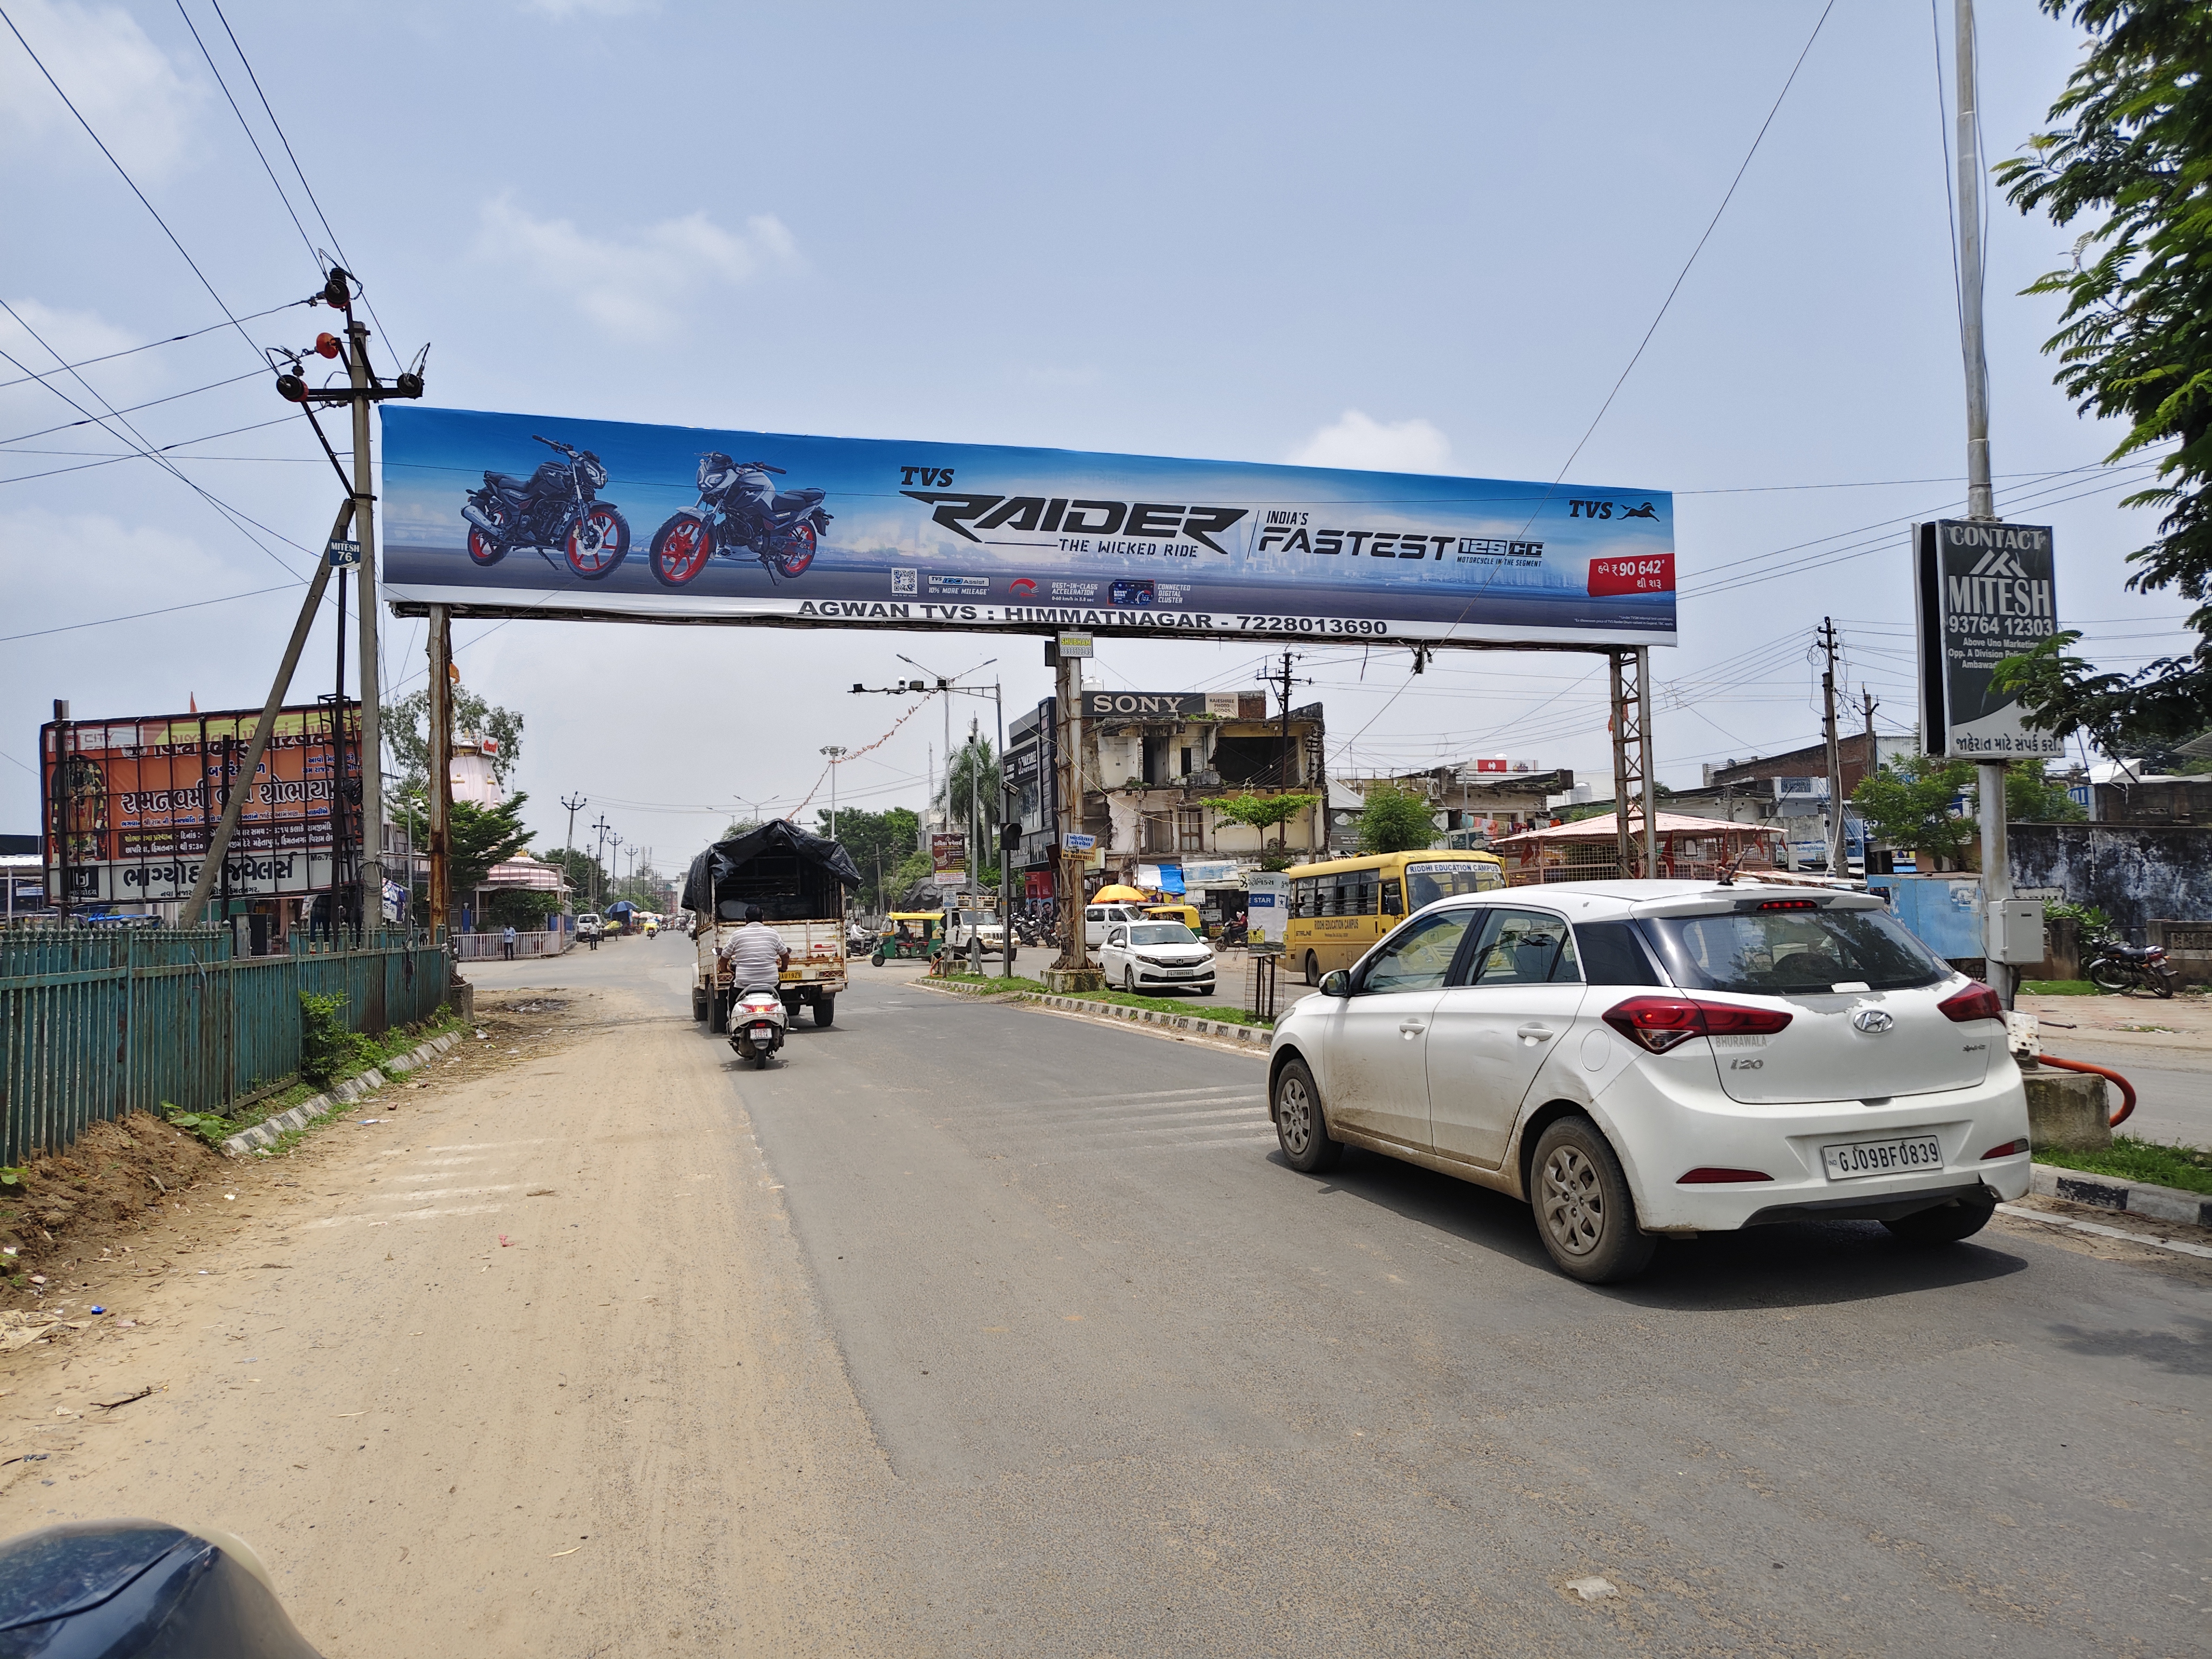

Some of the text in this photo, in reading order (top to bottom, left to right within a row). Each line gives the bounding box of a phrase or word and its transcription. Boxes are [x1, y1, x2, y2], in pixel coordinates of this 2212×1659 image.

[900, 466, 954, 487] TVS
[1266, 510, 1309, 525] INDIA'S
[1569, 500, 1613, 519] TVS
[899, 491, 1249, 554] RAIDER
[1258, 526, 1456, 560] FASTEST
[1950, 526, 2043, 550] CONTACT
[331, 542, 360, 552] MITESH
[1058, 538, 1198, 558] THE WICKED RIDE
[338, 551, 353, 562] 76
[1457, 556, 1494, 564] MOTORCYCLE
[1598, 562, 1609, 574] હવે
[1637, 577, 1646, 588] થી
[1948, 576, 2051, 617] MITESH
[797, 601, 909, 617] AGWAN
[920, 604, 977, 619] TVS
[988, 609, 994, 620] :
[1006, 608, 1213, 628] HIMMATNAGAR
[1236, 616, 1387, 635] 7228013690
[1948, 615, 2052, 636] 93764 12303
[1061, 637, 1091, 646] SHUBHAM
[1963, 637, 1985, 646] Above
[1987, 638, 2001, 647] Uno
[1948, 648, 1965, 659] Opp.
[1967, 649, 1973, 657] A
[1974, 649, 2004, 658] Division
[1093, 695, 1184, 712] SONY
[84, 731, 116, 743] CITY
[1956, 732, 1991, 751] જાહેરાત
[1994, 733, 2012, 751] માટે
[2015, 733, 2039, 752] સંપર્ક
[124, 859, 218, 887] ભાગ્યોદ
[1715, 1035, 1767, 1048] BHURAWALA
[1730, 1057, 1764, 1069] i20
[1838, 1142, 1939, 1171] GJ09BF0839
